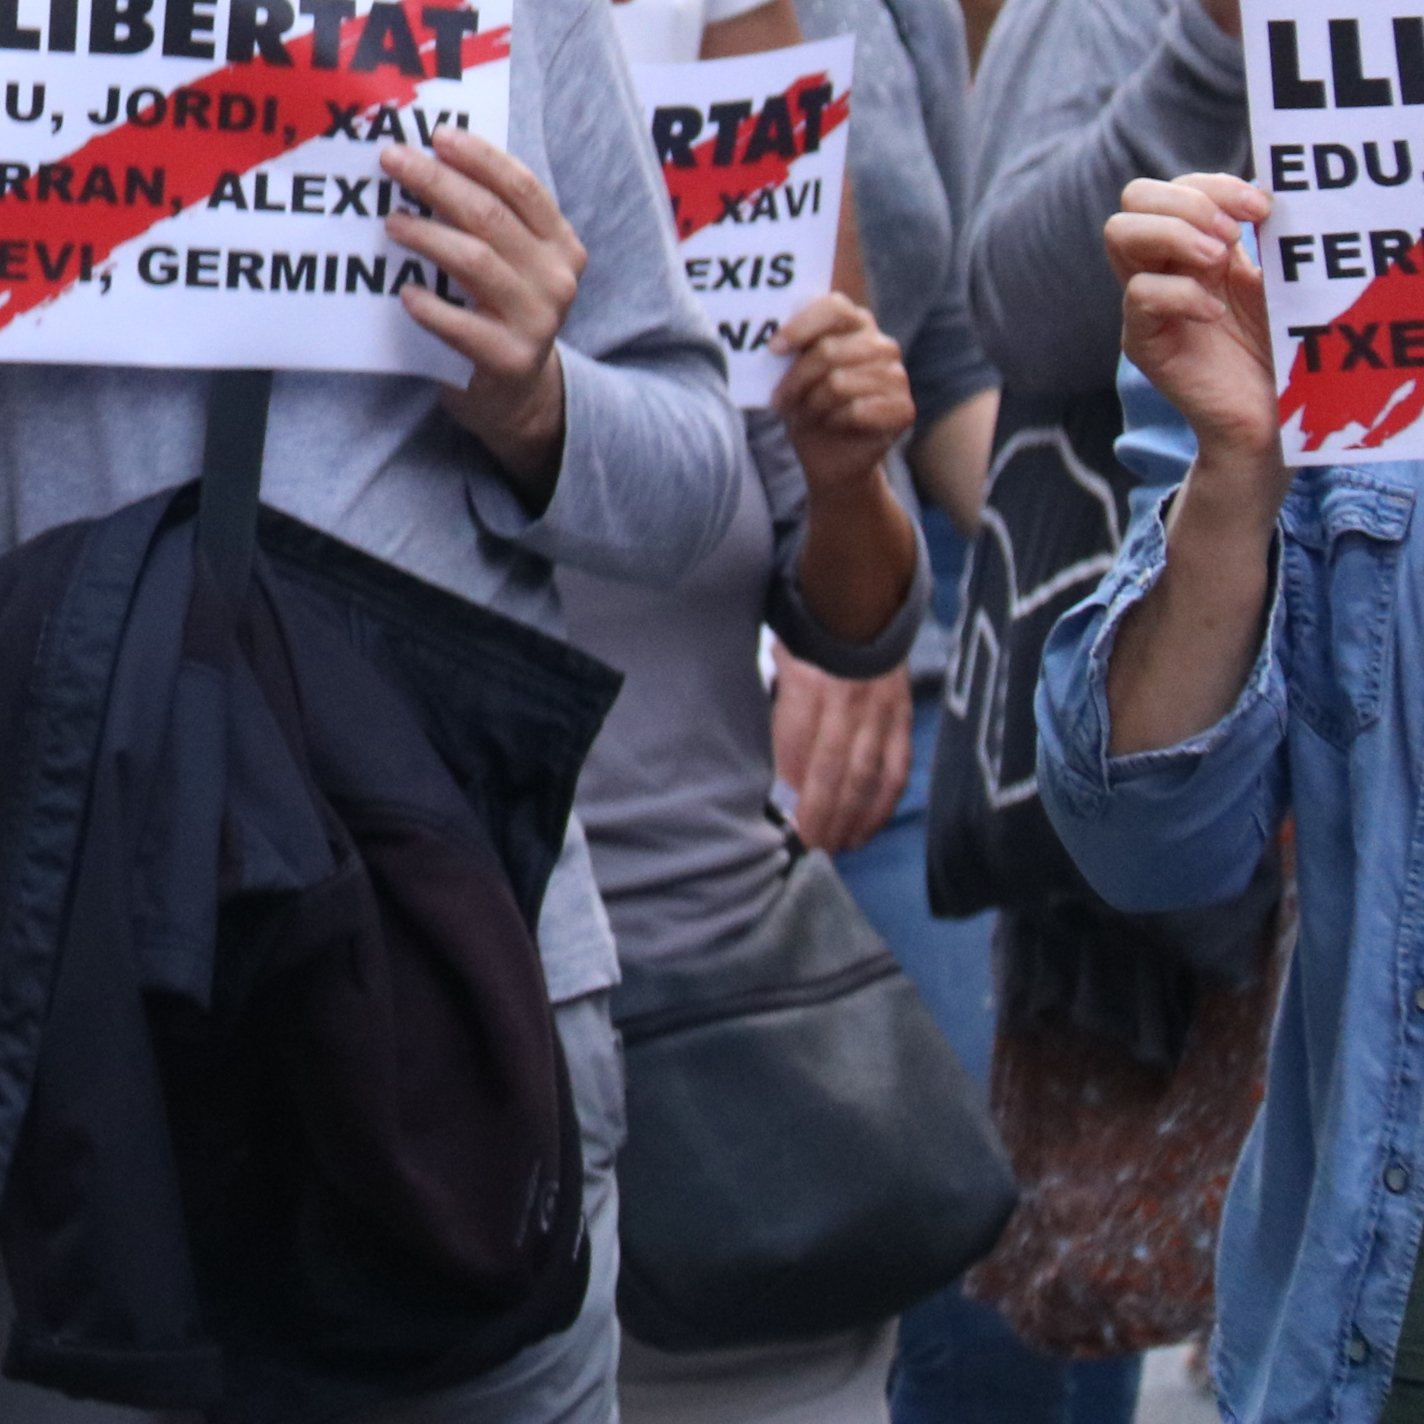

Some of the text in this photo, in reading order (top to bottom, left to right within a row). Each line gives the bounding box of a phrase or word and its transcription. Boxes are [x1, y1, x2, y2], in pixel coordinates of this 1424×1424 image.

[87, 85, 298, 146] JORDI,
[1269, 140, 1424, 192] EDU
[714, 178, 821, 226] XAVI
[137, 244, 466, 307] GERMINAL
[685, 253, 795, 291] EXIS
[1288, 319, 1424, 373] TXE
